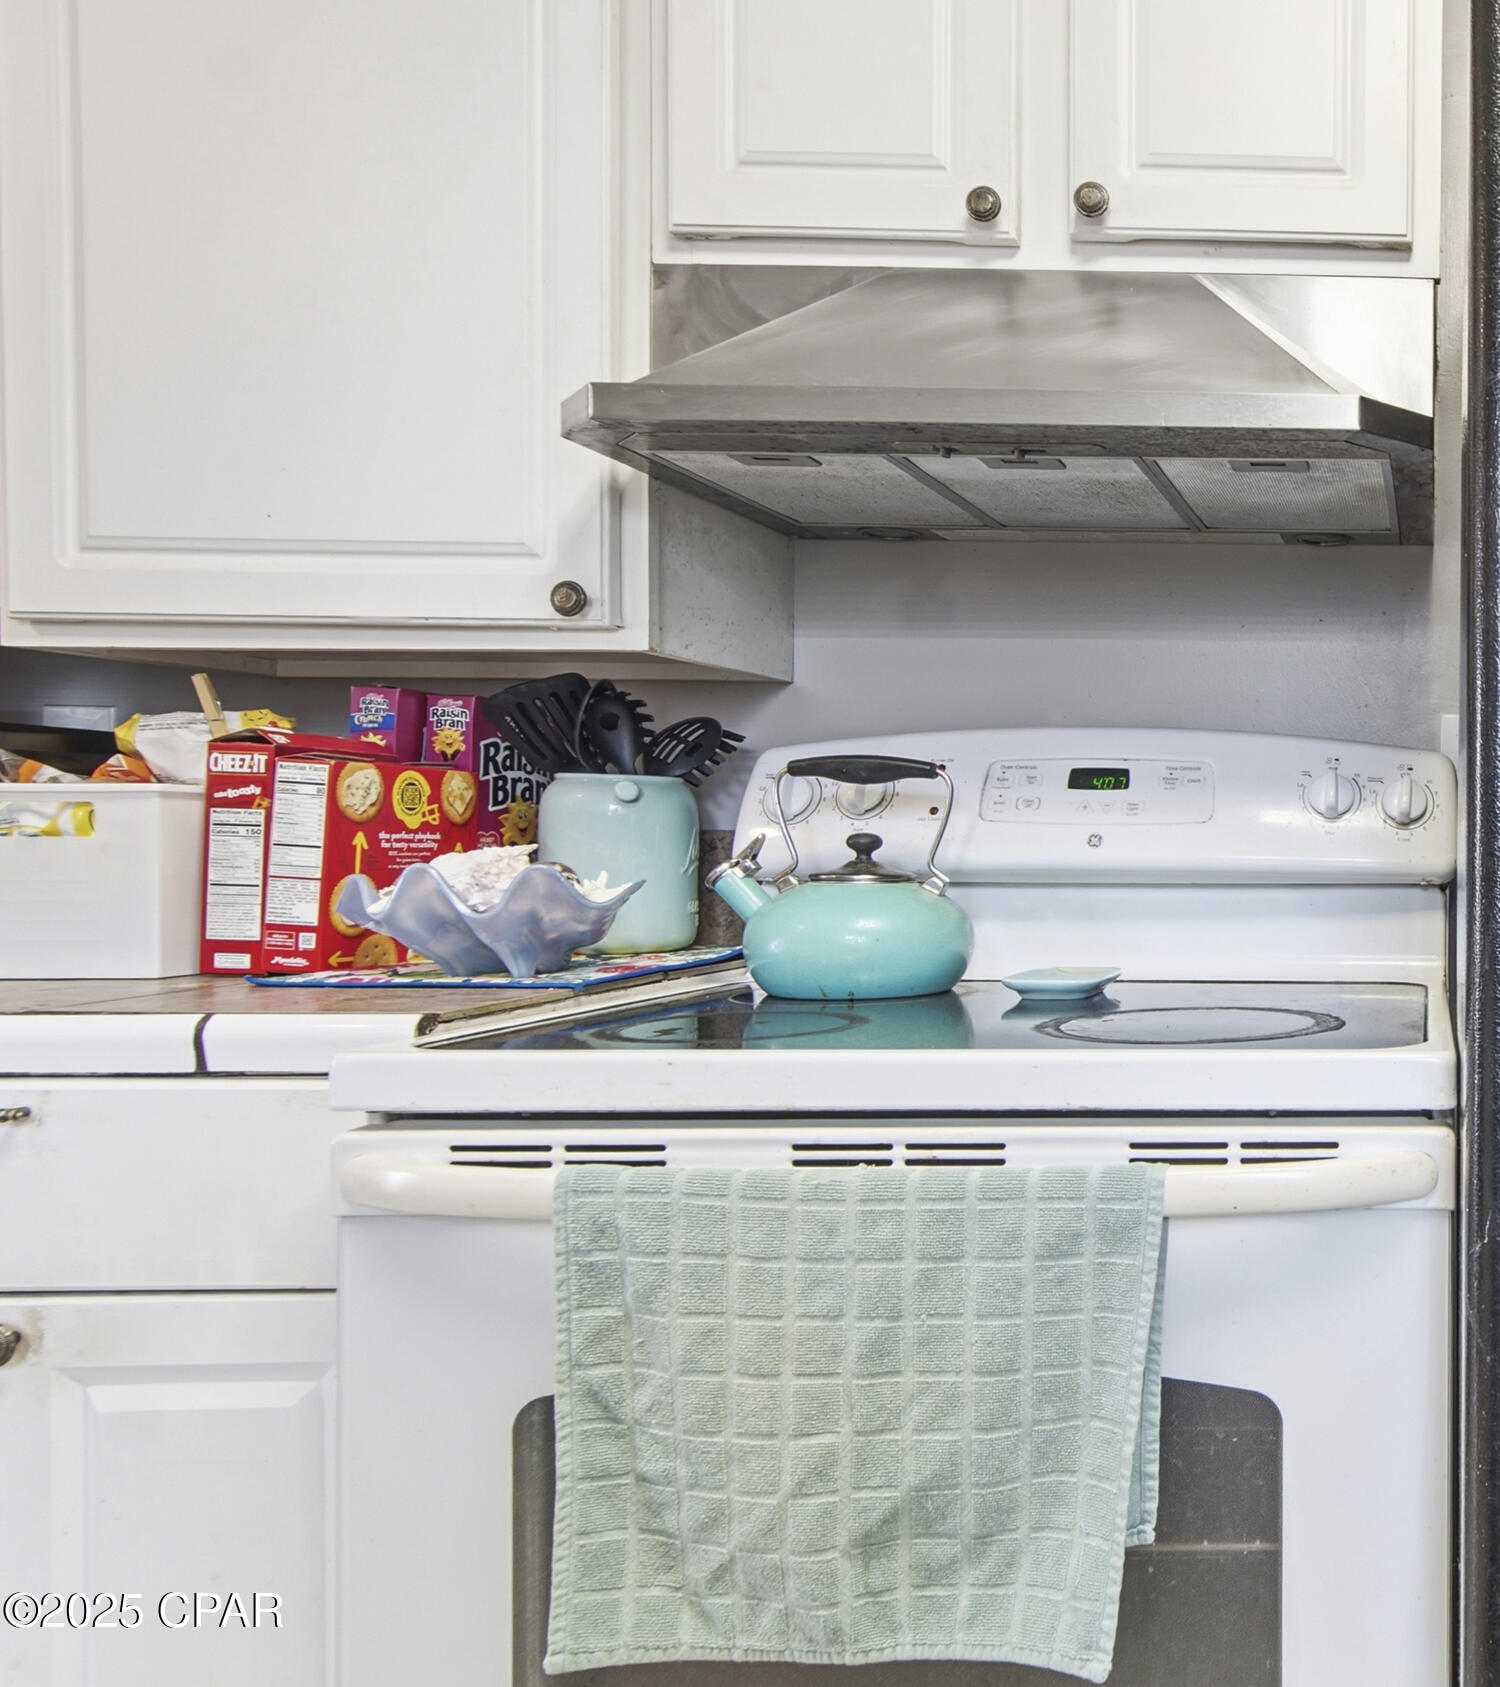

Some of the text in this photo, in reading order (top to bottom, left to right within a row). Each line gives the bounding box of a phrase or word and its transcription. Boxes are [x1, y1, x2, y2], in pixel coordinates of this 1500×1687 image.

[431, 708, 469, 720] Raisin
[434, 717, 466, 731] Bran
[245, 828, 262, 836] 150
